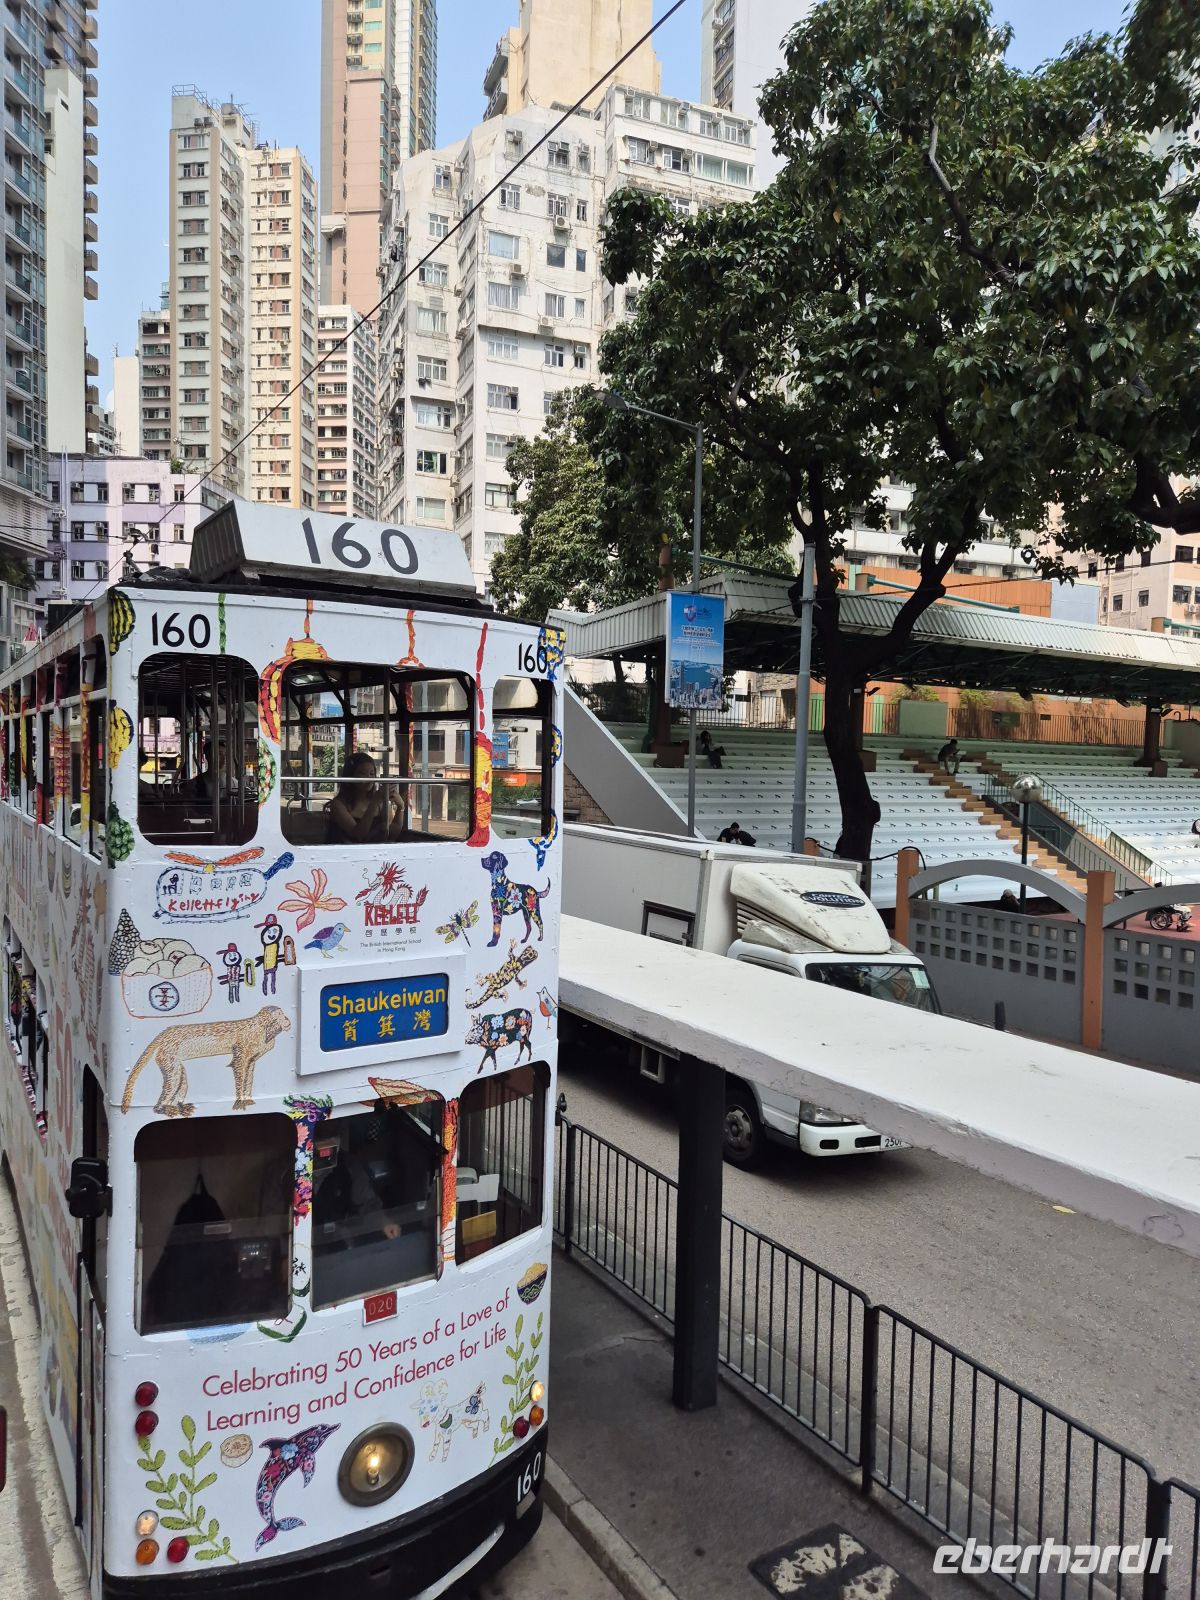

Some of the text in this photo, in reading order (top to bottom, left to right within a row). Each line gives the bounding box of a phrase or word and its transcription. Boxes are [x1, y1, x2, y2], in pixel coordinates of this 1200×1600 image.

[301, 517, 419, 575] 160
[151, 611, 211, 649] 160
[518, 642, 548, 674] 160
[364, 903, 418, 927] KELLETT
[801, 896, 865, 904] EVOLUTION
[327, 987, 446, 1017] Shaukeiwan
[342, 1008, 432, 1042] 筲箕灣
[368, 1297, 393, 1316] 020
[202, 1287, 510, 1397] Celebrating 50 Years of a Love of
[207, 1322, 507, 1431] Learning and Confidence for Life
[517, 1451, 542, 1503] 160
